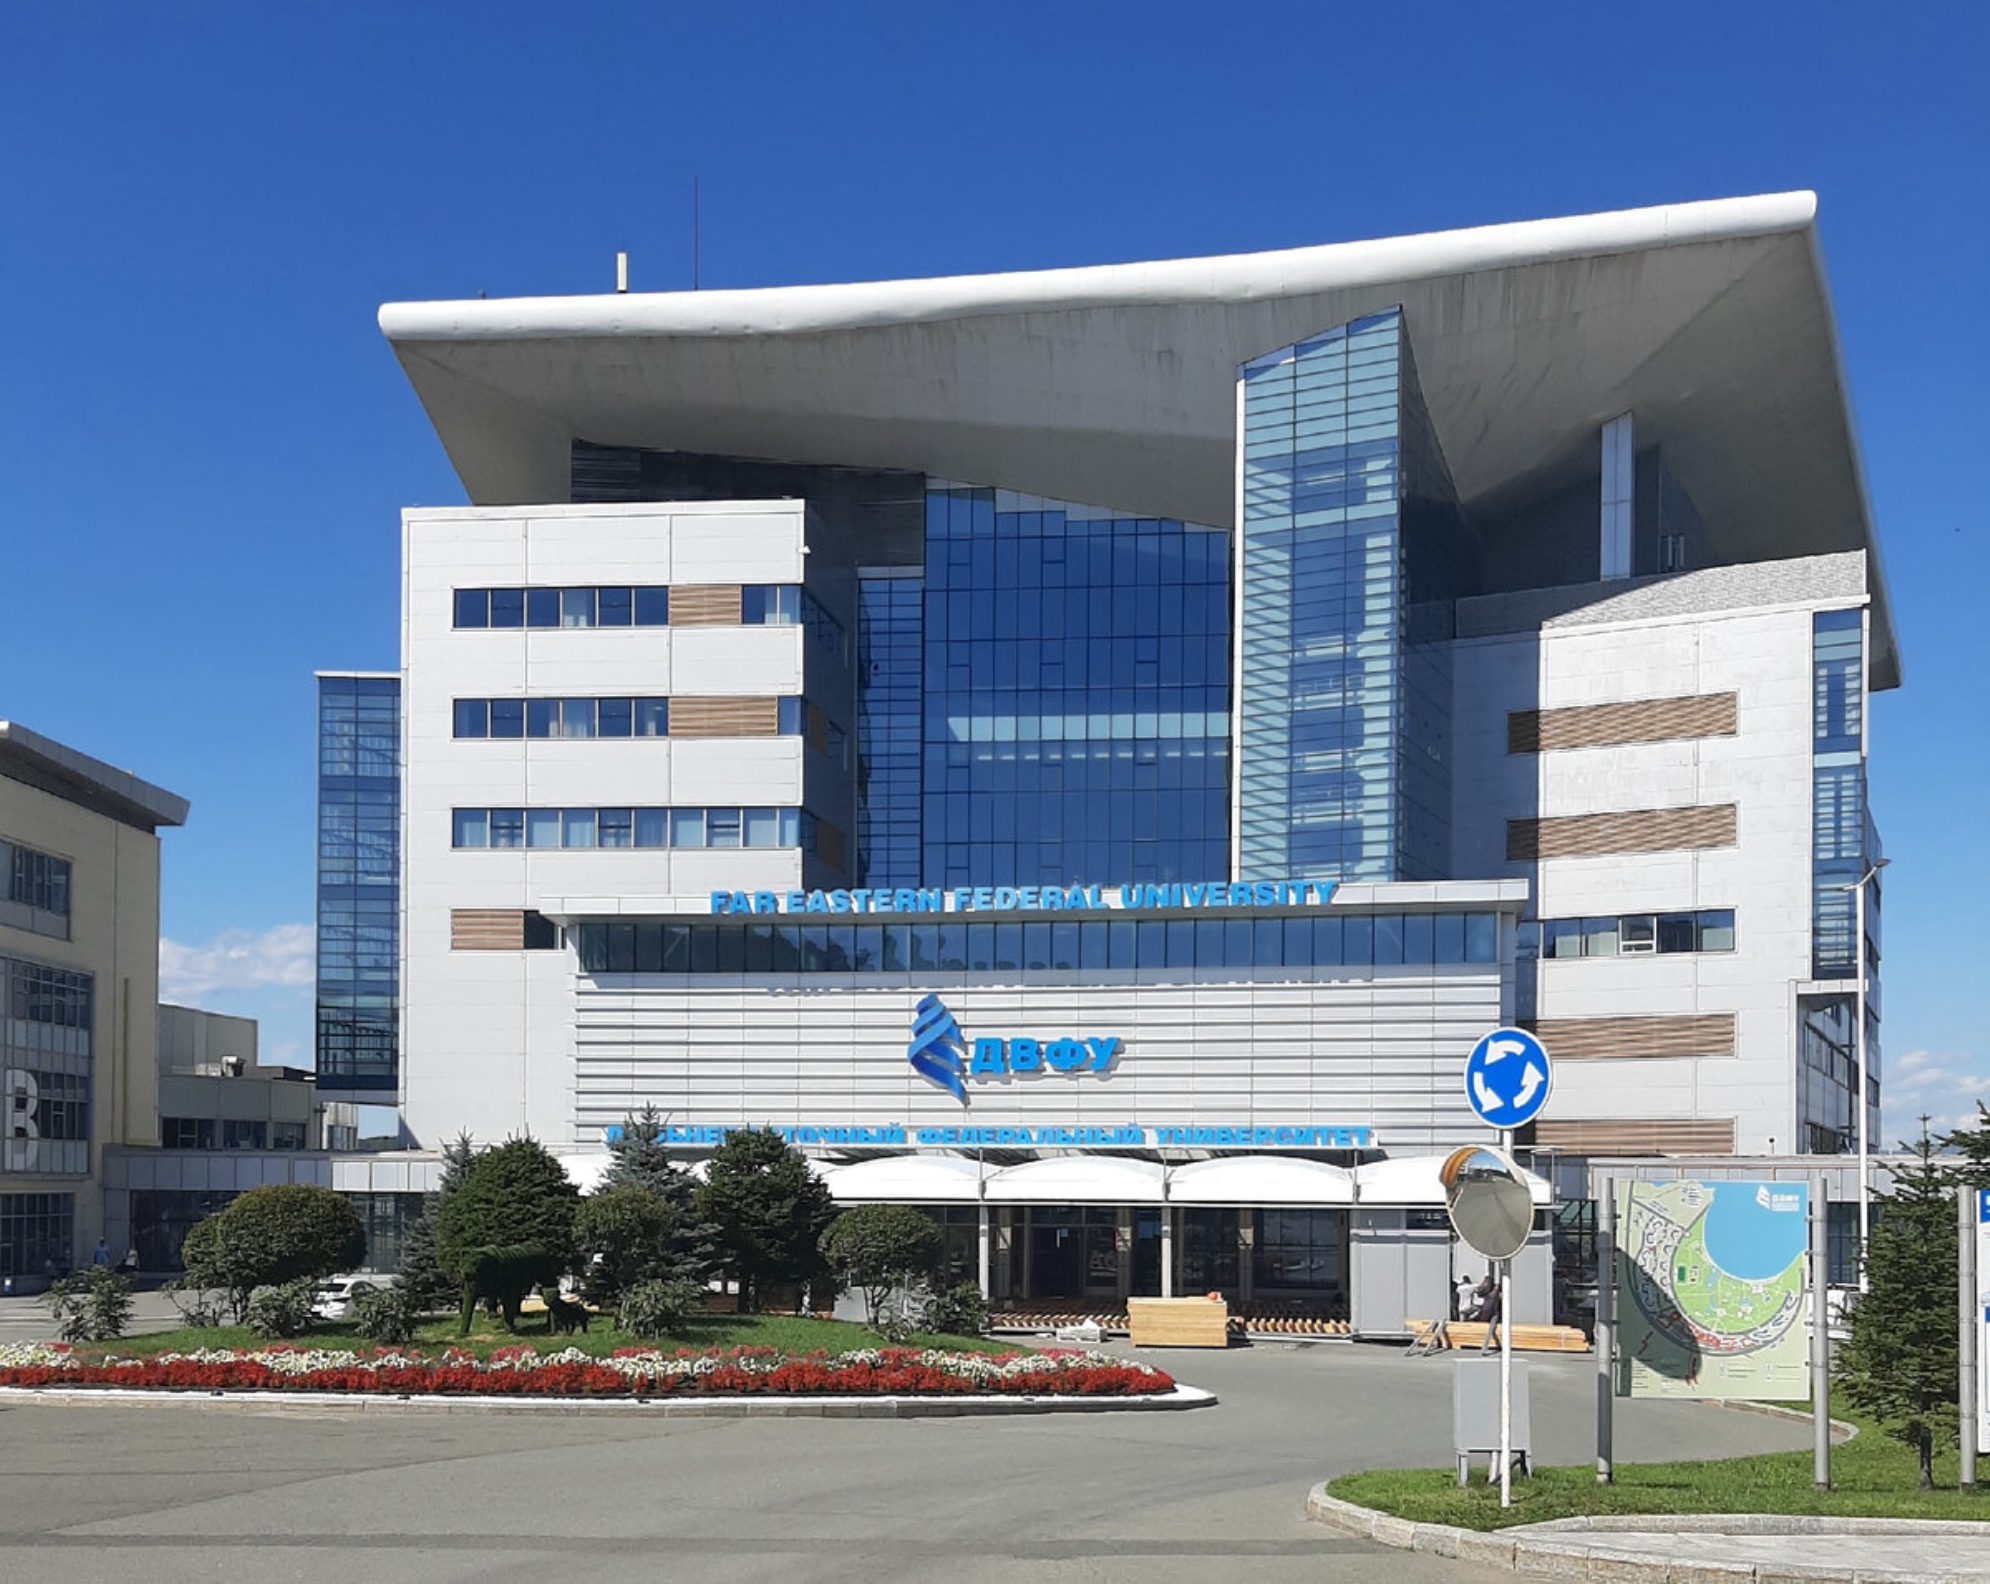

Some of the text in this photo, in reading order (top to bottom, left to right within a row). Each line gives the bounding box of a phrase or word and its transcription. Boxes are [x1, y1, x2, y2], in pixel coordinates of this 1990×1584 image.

[710, 879, 1337, 914] FAR EASTERN FEDERAL UNIVERSITY
[970, 1037, 1118, 1076] ДВФУ
[917, 1122, 1145, 1145] ФЕДЕРАЛЬНЫЙ
[1155, 1126, 1371, 1146] УНИВЕРСИТЕТ
